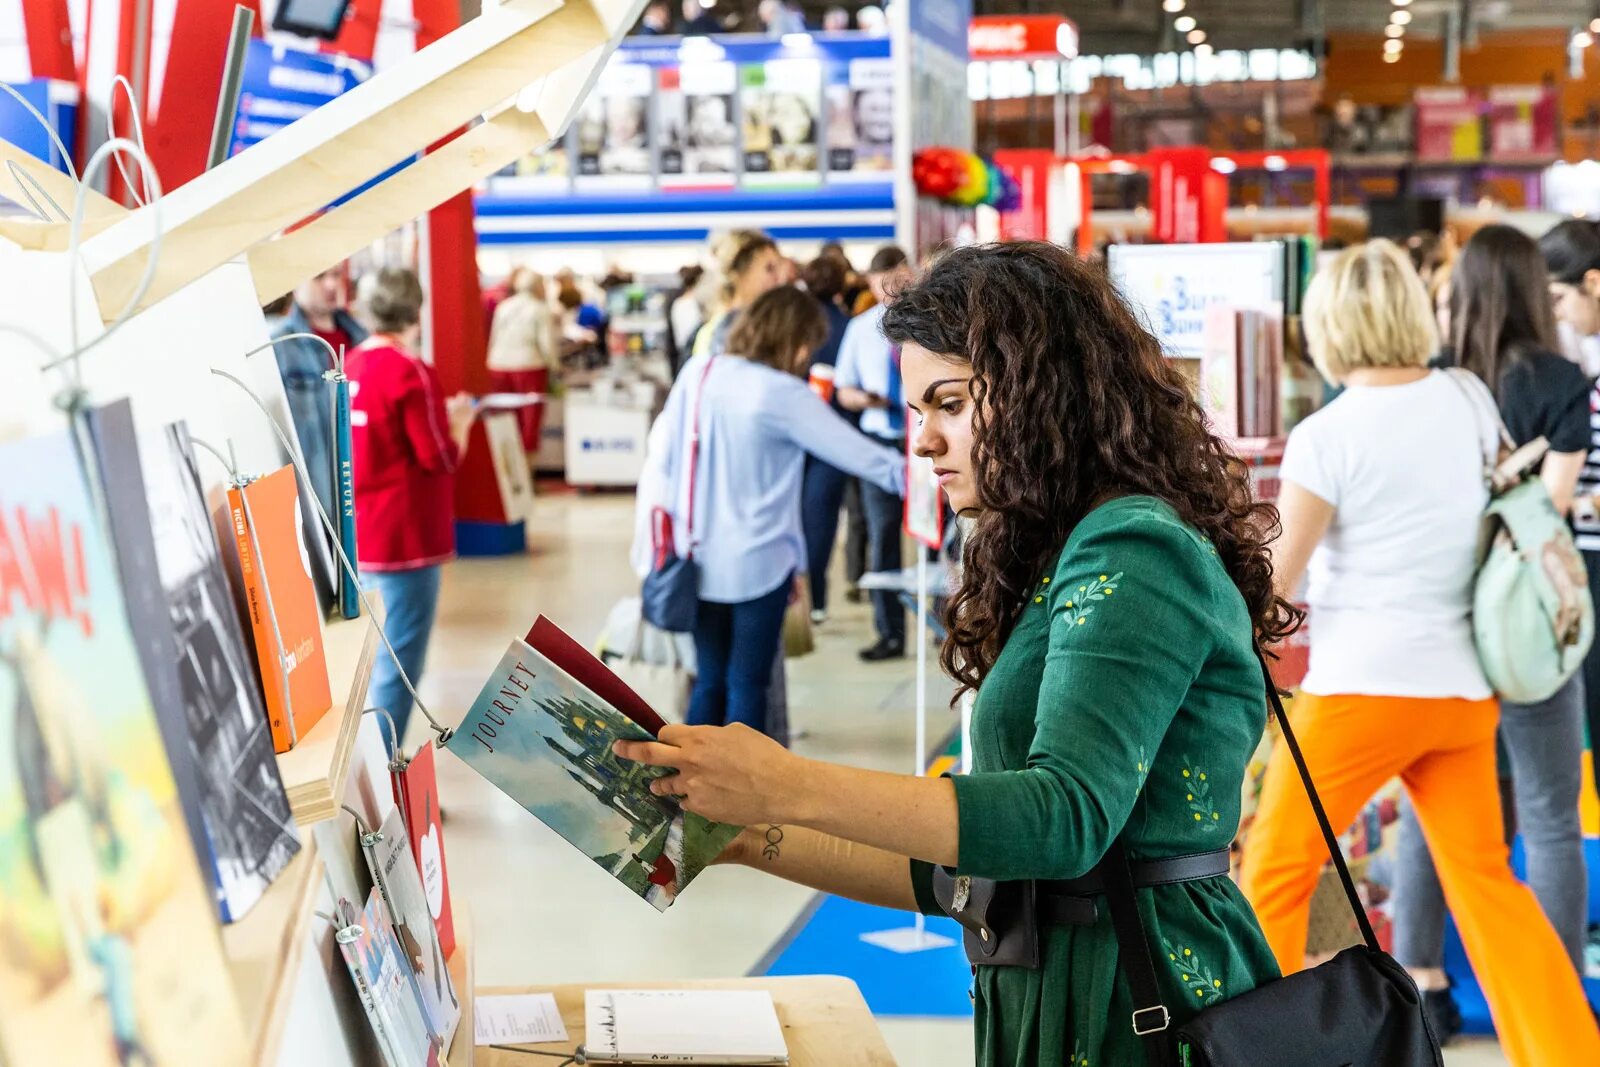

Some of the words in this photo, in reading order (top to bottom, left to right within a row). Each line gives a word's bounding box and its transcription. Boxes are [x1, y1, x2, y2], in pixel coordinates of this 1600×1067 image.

[342, 460, 353, 517] RETURN
[233, 507, 245, 536] VICINO
[471, 661, 537, 754] JOURNEY
